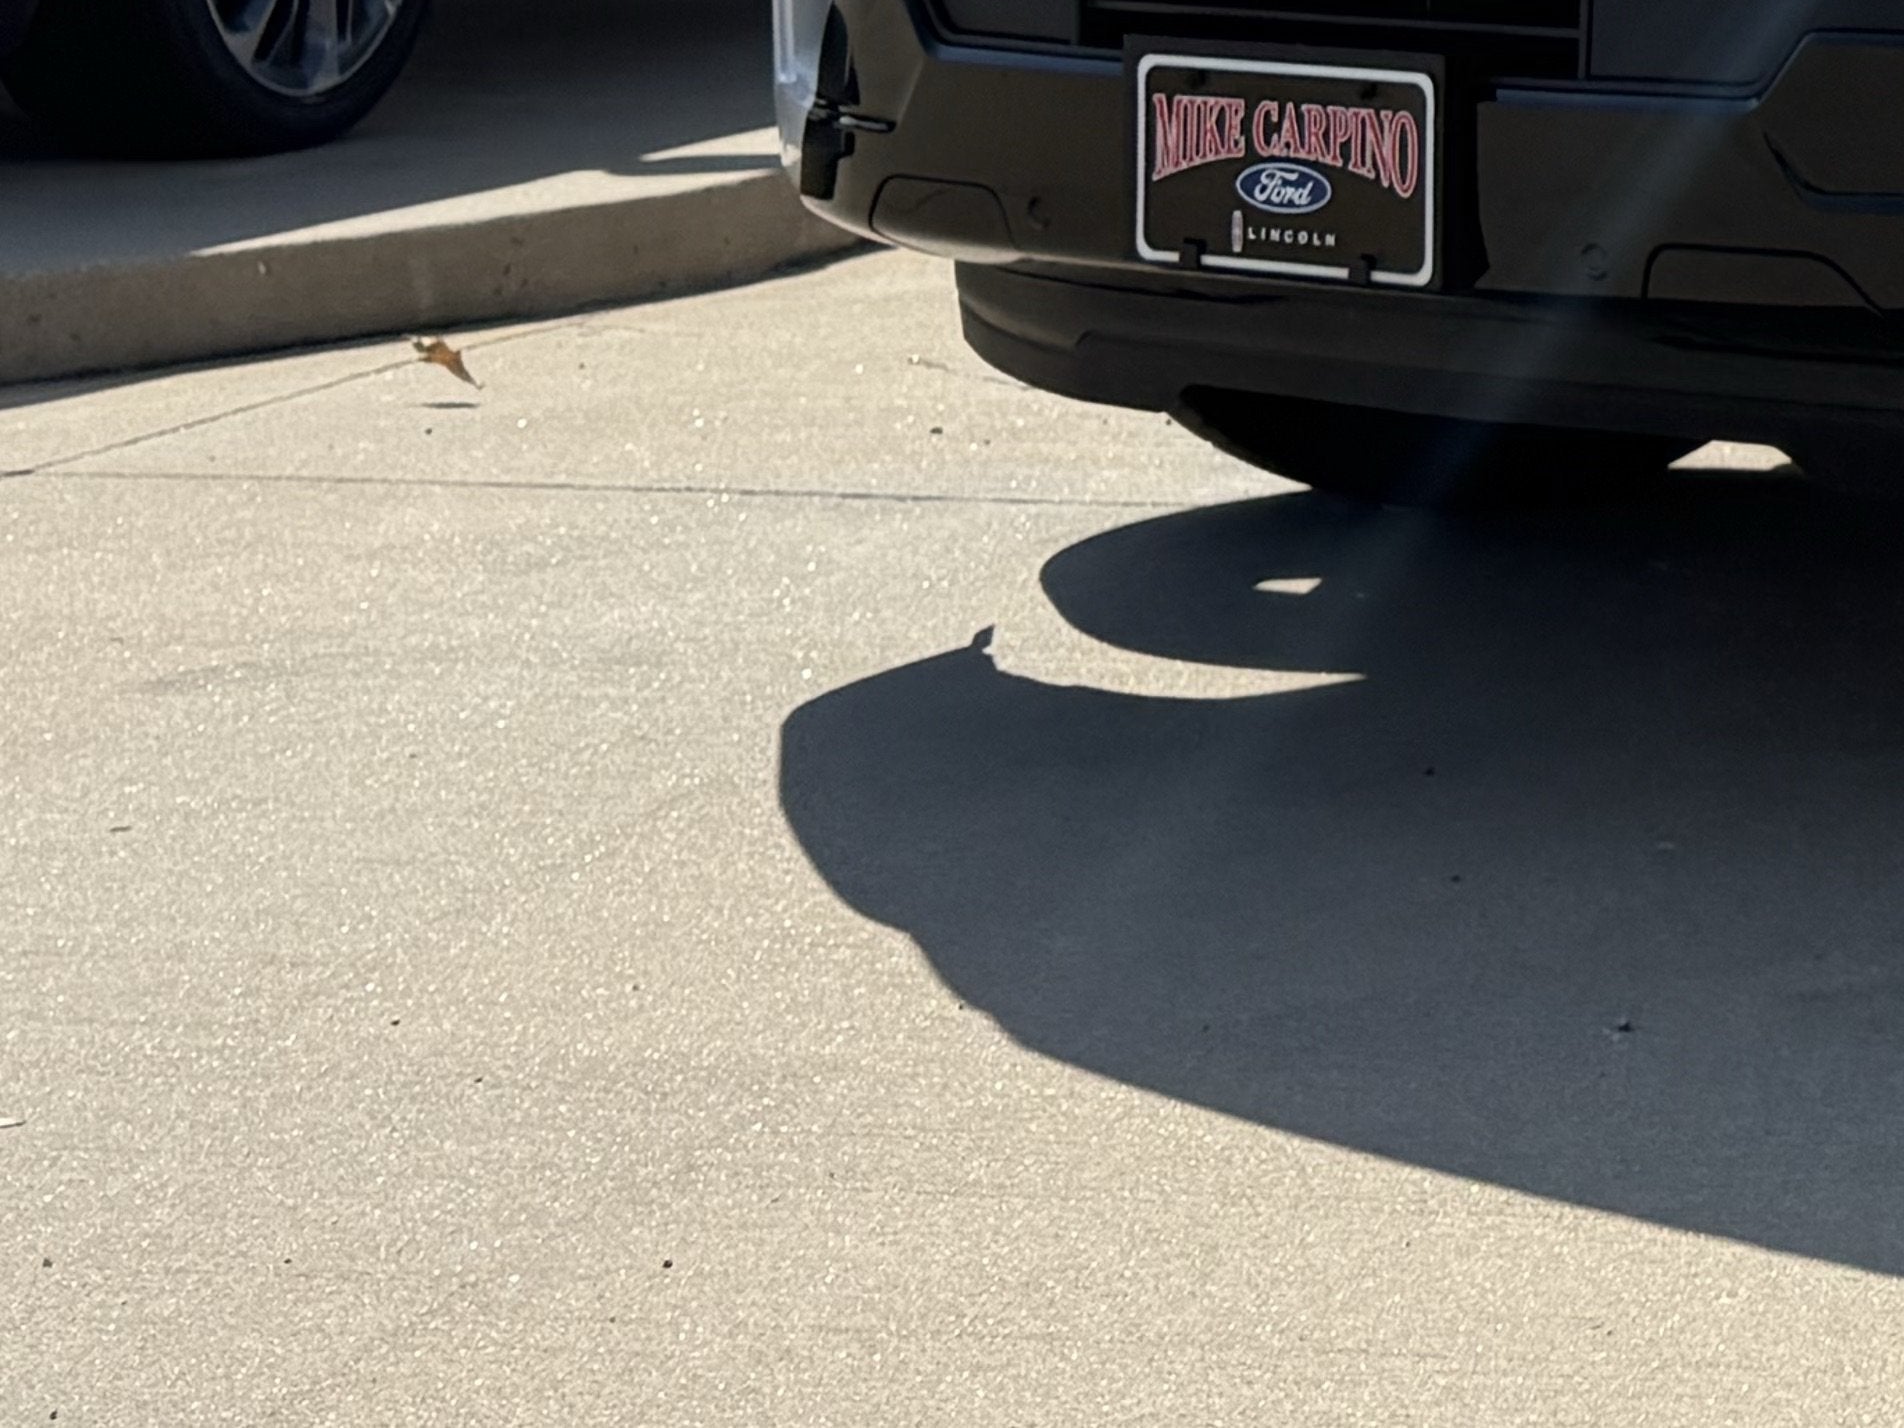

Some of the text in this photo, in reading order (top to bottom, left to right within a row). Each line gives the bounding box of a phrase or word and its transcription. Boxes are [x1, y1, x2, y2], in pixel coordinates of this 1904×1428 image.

[1152, 93, 1419, 198] MIKE CARPINO
[1253, 168, 1314, 206] Ford
[1247, 226, 1337, 248] LINCOLN
